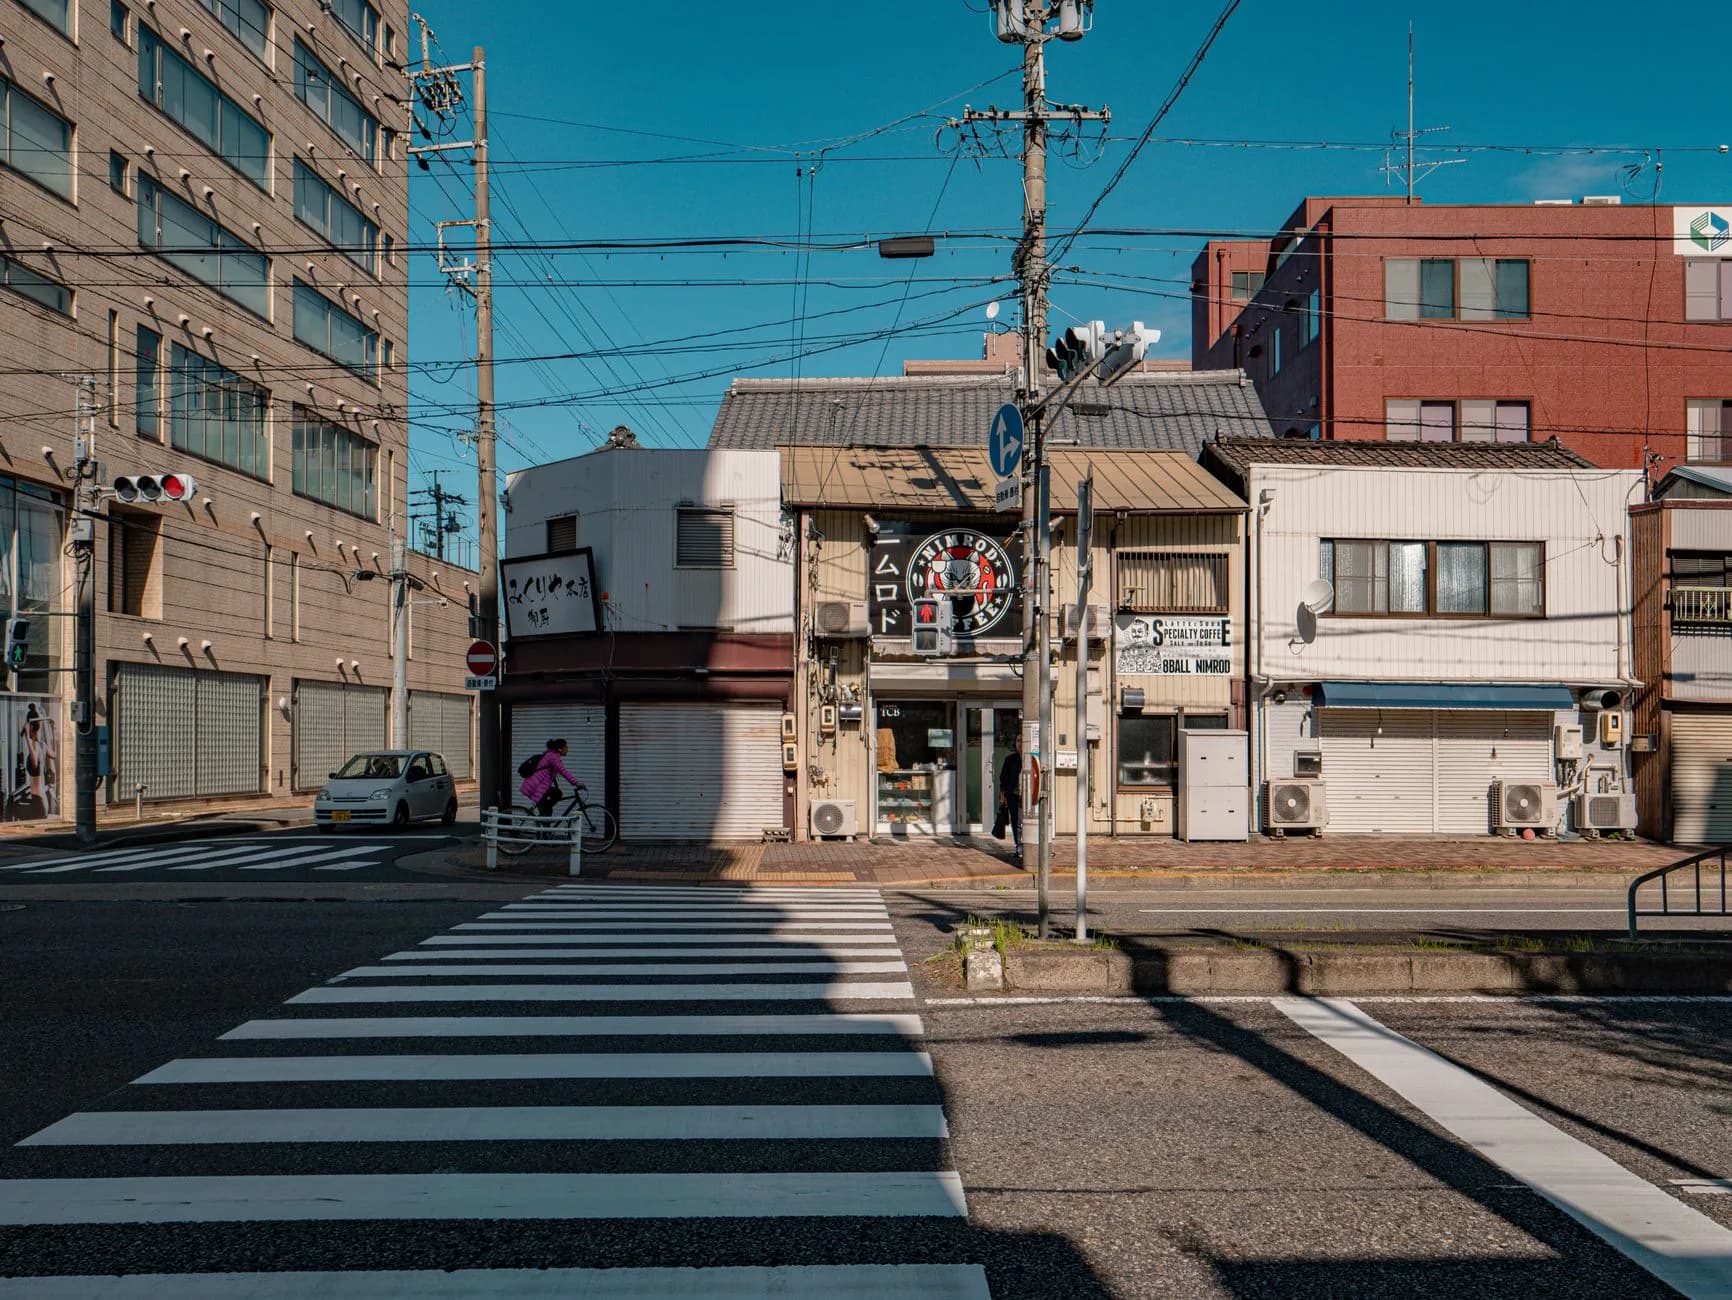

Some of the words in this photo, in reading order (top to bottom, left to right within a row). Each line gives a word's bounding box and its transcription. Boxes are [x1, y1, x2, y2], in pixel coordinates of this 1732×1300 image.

[922, 534, 999, 561] NIMROD
[874, 530, 900, 633] ニムロド
[1153, 619, 1198, 647] SPECIALTY
[1200, 619, 1231, 647] COFFEE
[1163, 659, 1191, 673] 8BALL
[1196, 659, 1231, 673] NIMROD
